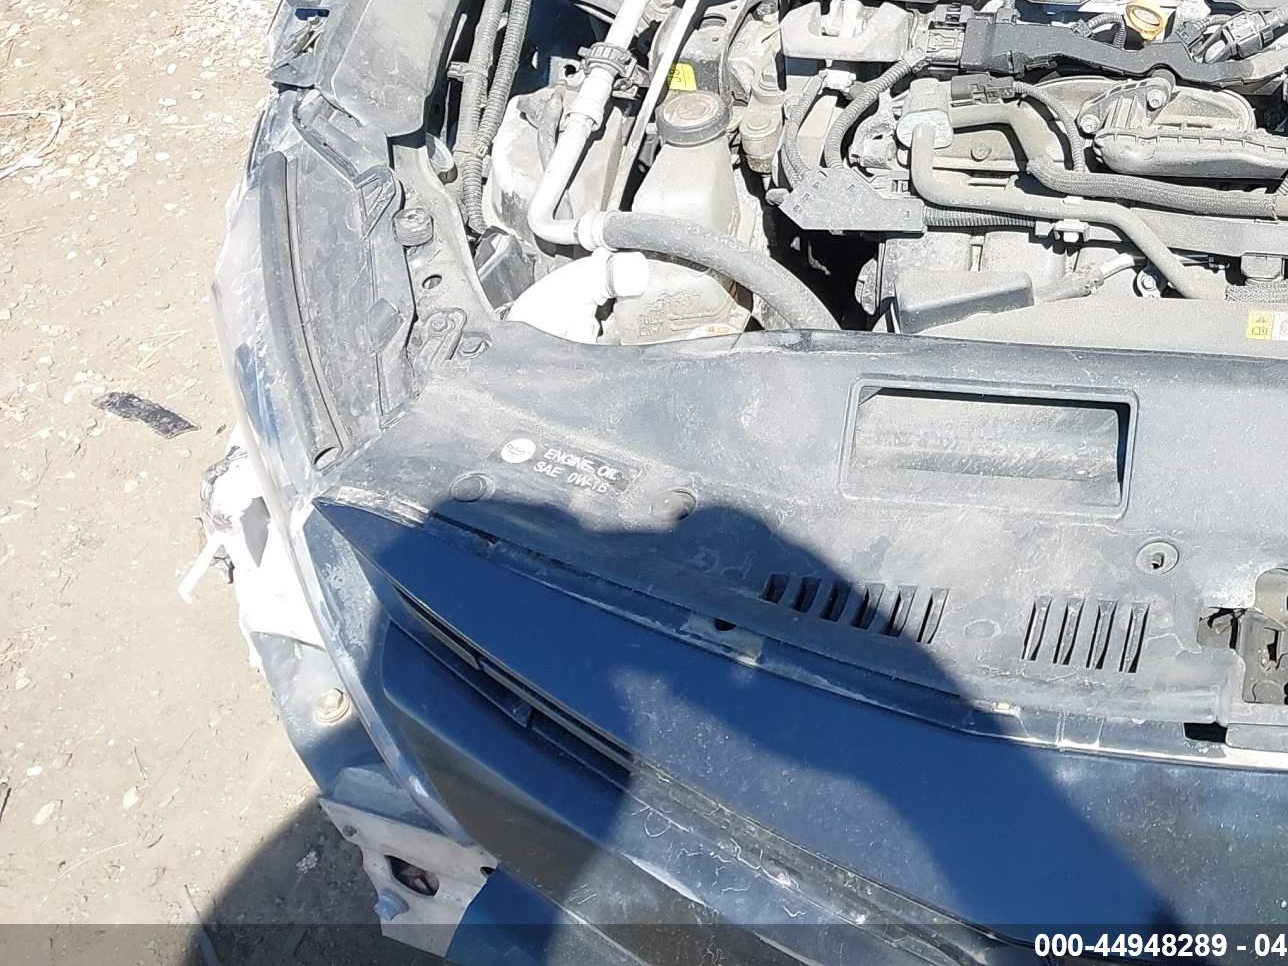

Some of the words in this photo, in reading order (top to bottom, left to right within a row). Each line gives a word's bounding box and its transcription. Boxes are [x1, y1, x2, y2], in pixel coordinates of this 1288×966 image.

[533, 461, 565, 479] SAE
[543, 447, 595, 472] ENGINE
[597, 465, 618, 481] OIL
